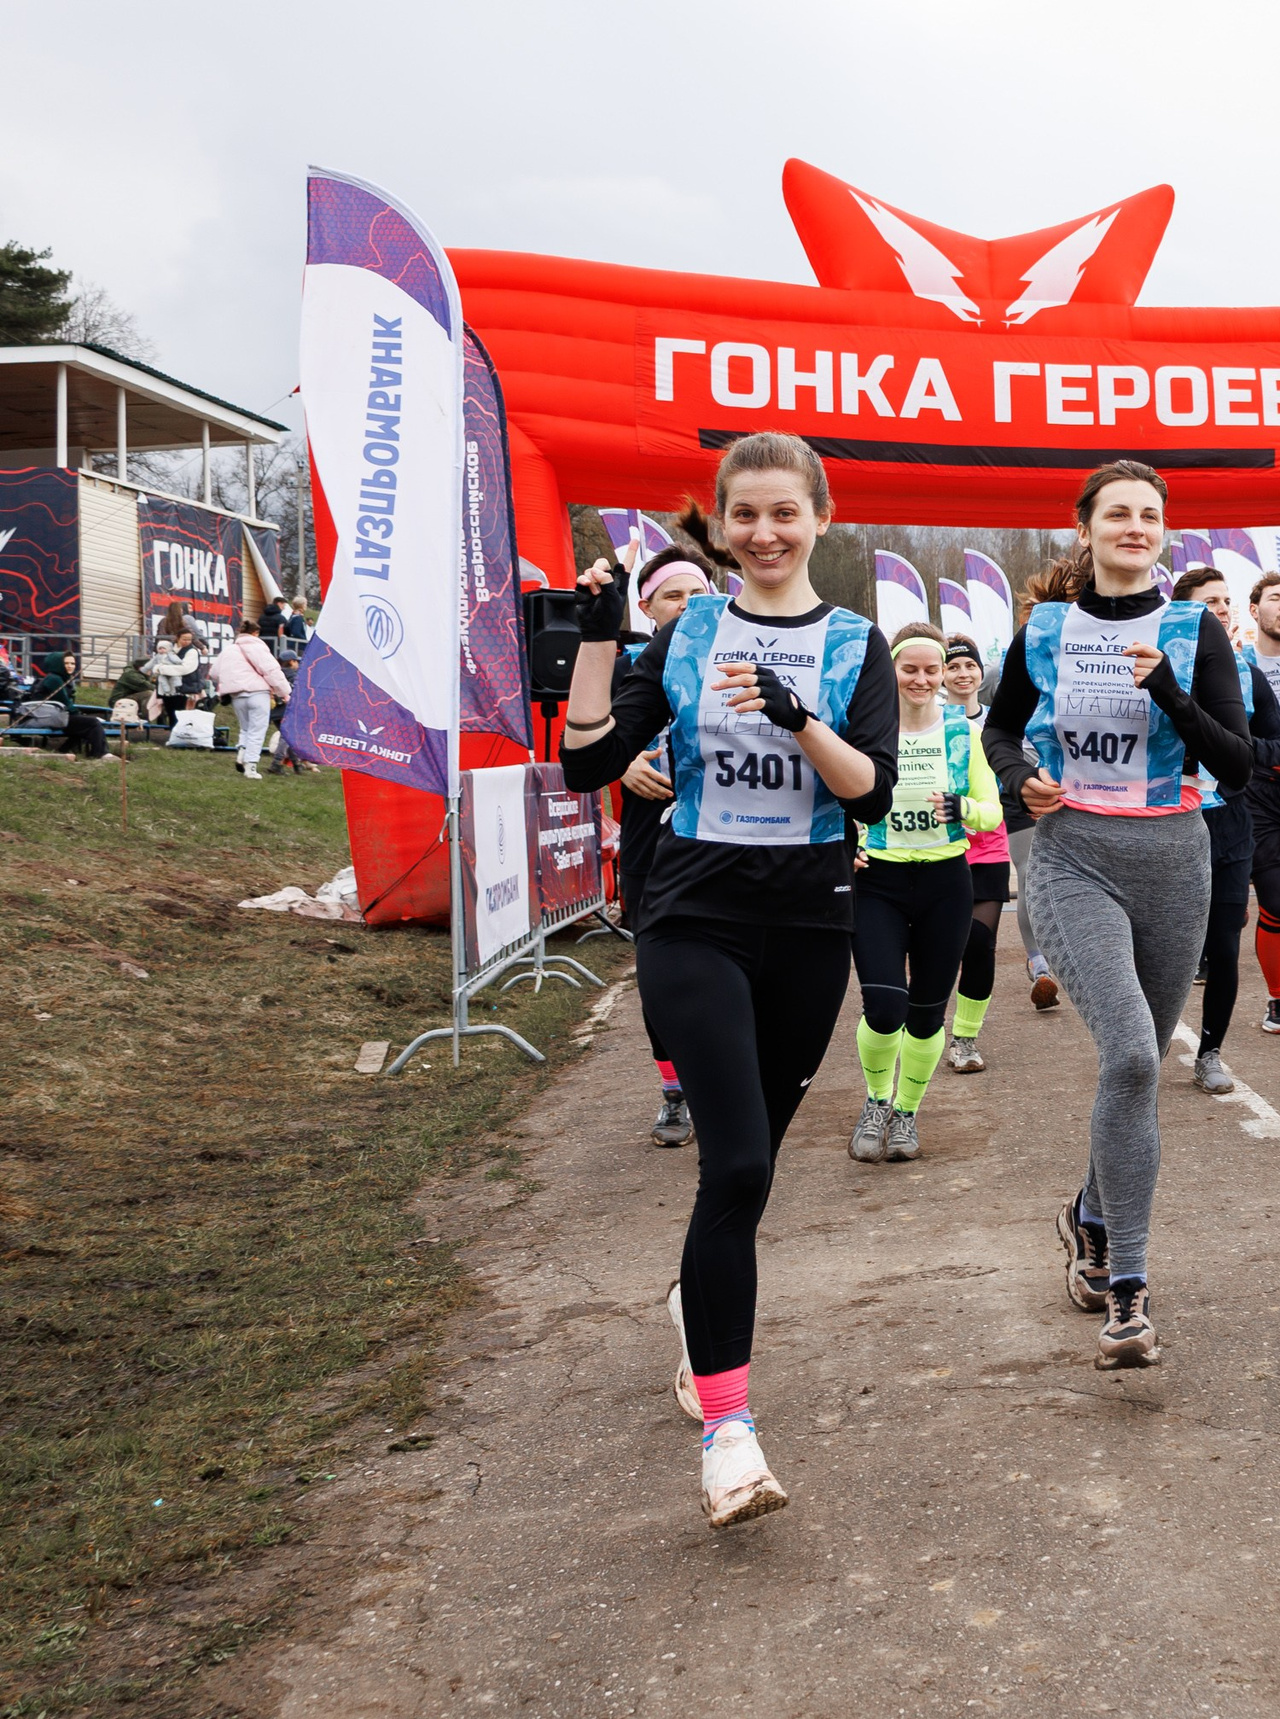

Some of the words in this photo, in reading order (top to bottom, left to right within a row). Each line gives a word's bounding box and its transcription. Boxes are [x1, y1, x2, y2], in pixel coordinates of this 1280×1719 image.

[655, 337, 963, 421] ГОНКА
[153, 539, 229, 597] ГОНКА
[1065, 642, 1103, 653] ГОНКА
[714, 650, 758, 662] ГОНКА
[763, 651, 816, 664] ГЕРОЕВ
[1088, 688, 1134, 696] DEVELOPMENT
[1066, 694, 1151, 723] МАША
[911, 747, 942, 755] ГЕРОЕВ
[1064, 731, 1139, 765] 5407
[715, 750, 802, 791] 5401
[898, 761, 935, 772] minex
[1083, 783, 1129, 793] ГАЗПРОМБАНК
[736, 814, 791, 825] ГАЗПРОМБАНК
